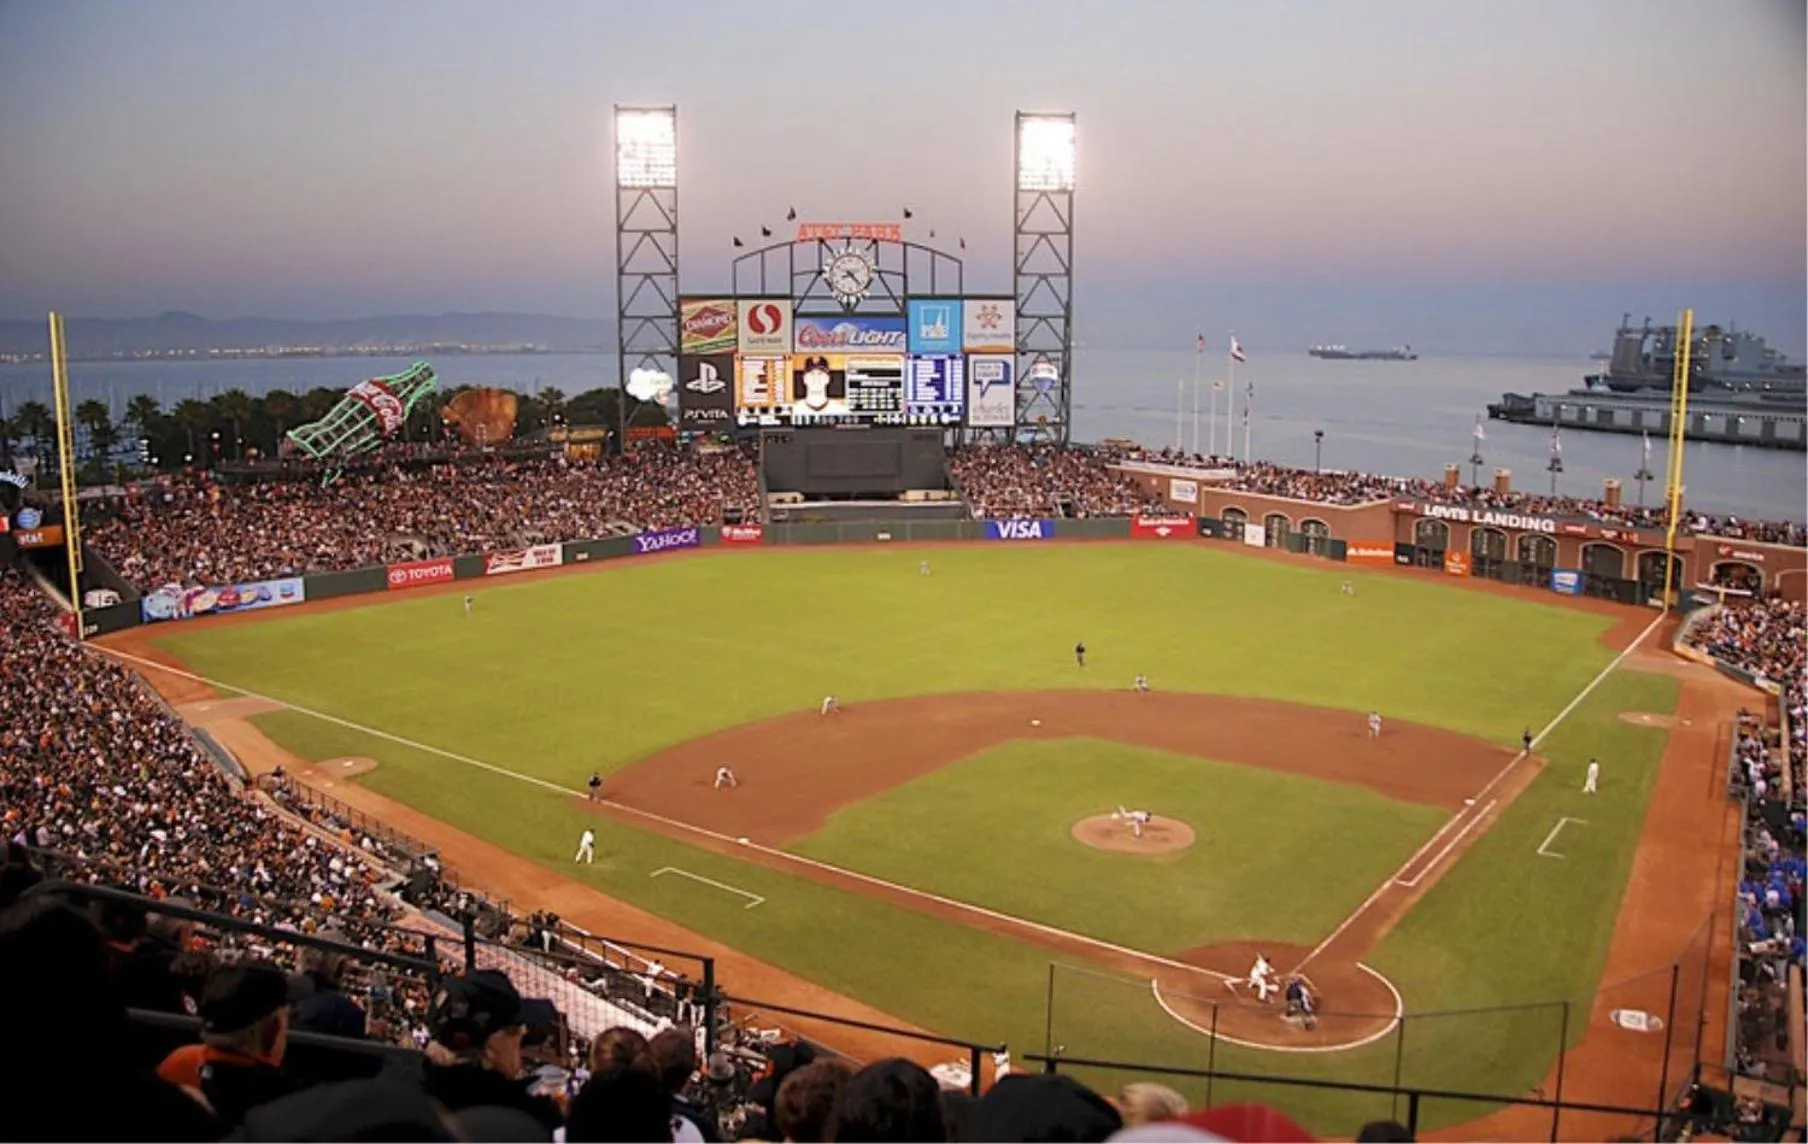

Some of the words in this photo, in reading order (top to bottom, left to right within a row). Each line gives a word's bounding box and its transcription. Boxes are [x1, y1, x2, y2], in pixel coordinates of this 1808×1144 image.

[847, 330, 903, 346] LIGHT
[995, 520, 1042, 538] VISA
[1472, 510, 1556, 532] LANDING
[637, 529, 697, 552] YAHOO!
[408, 565, 453, 579] TOYOTA
